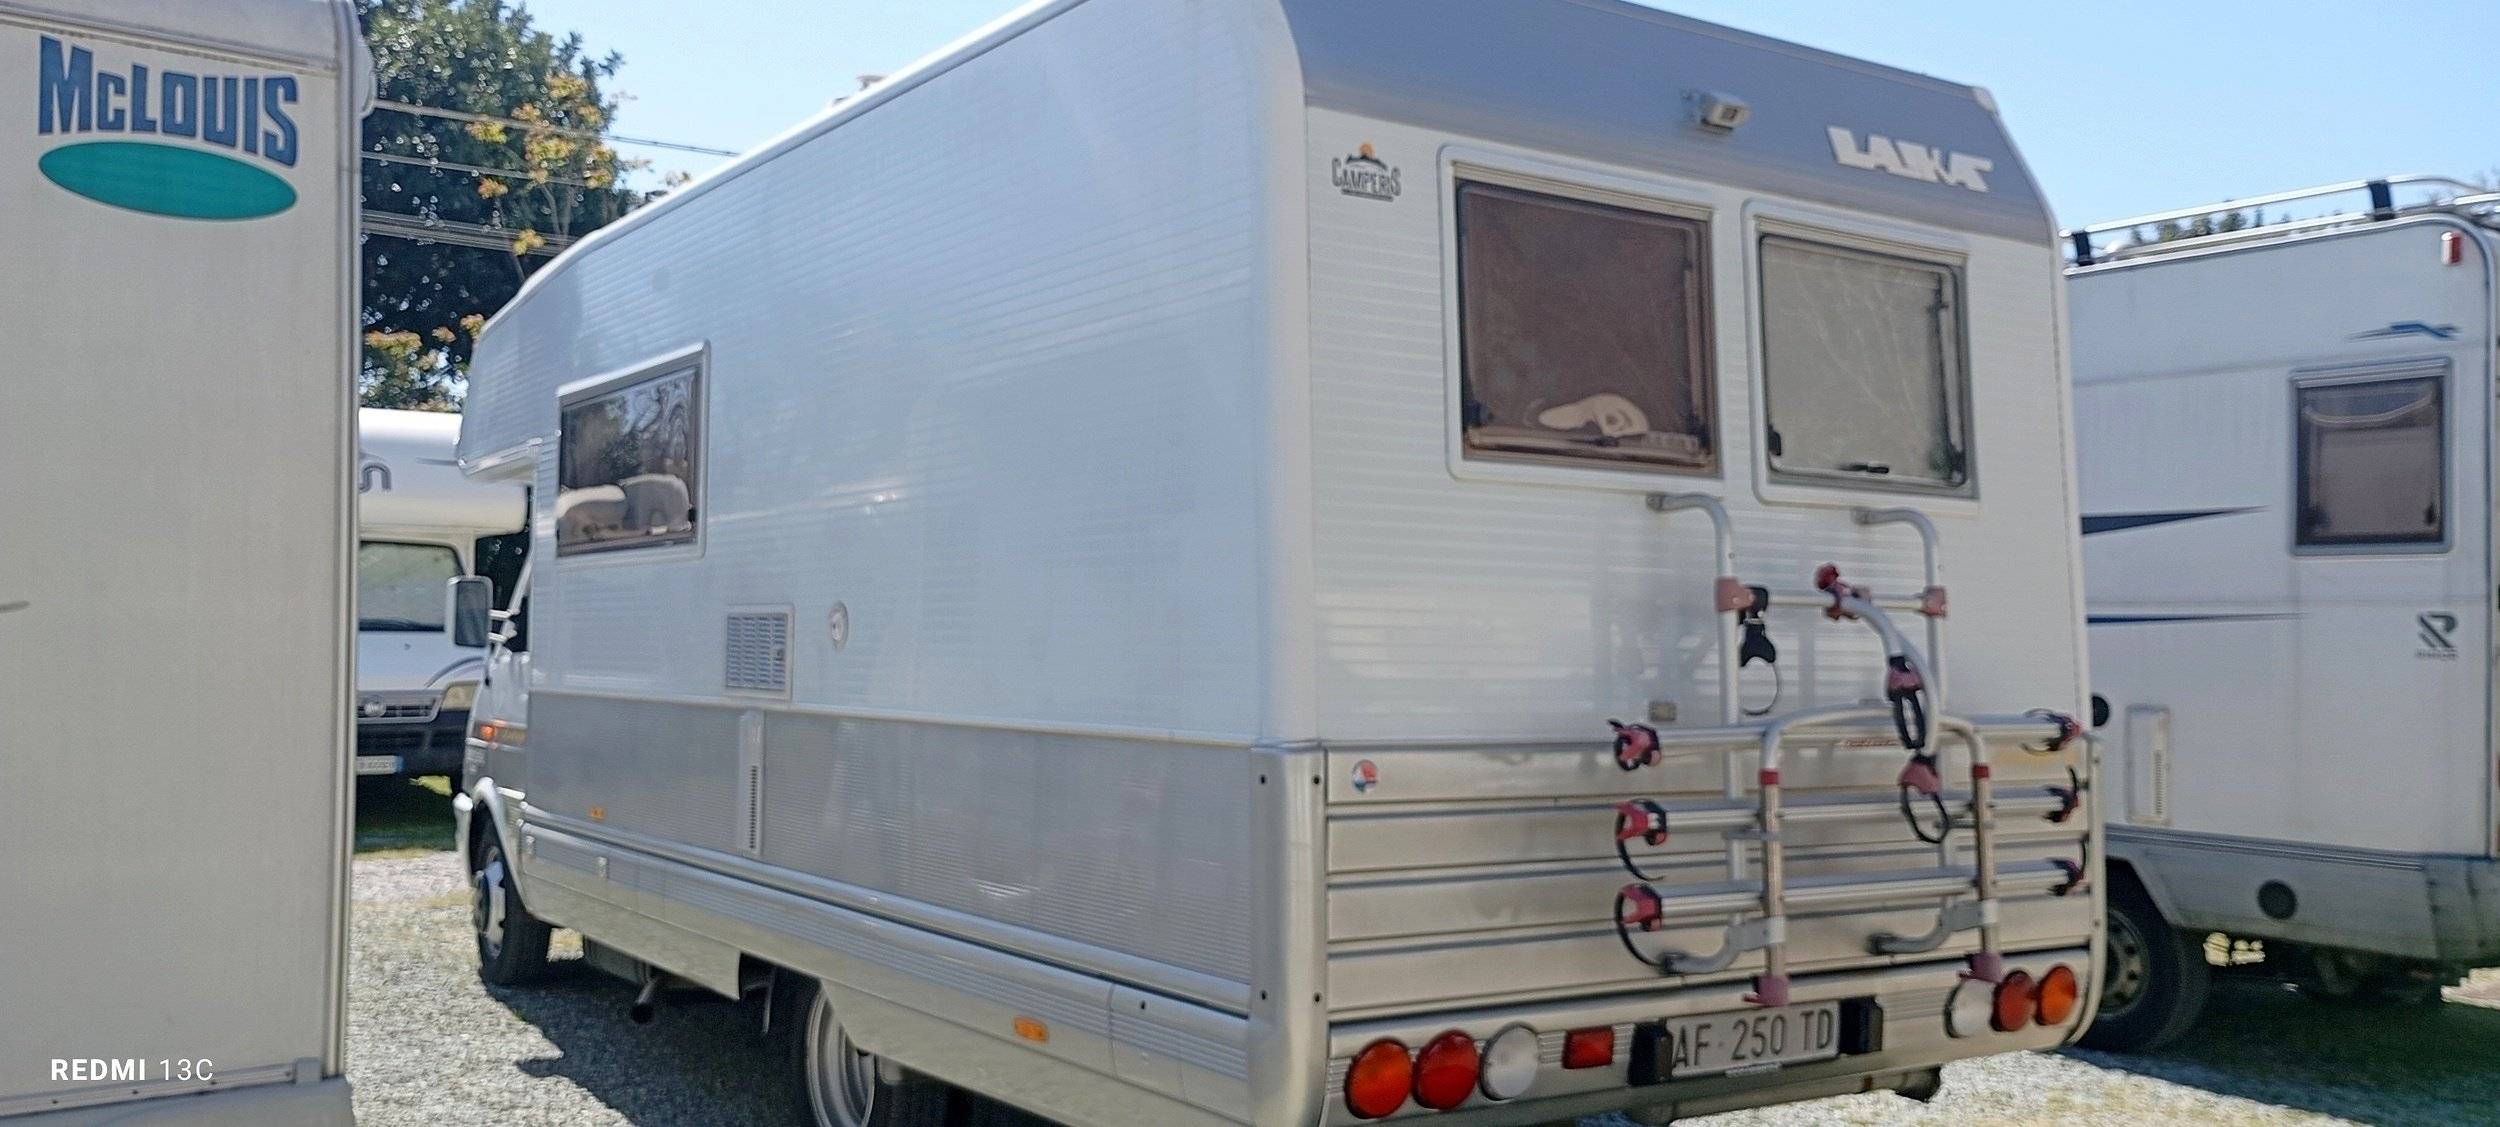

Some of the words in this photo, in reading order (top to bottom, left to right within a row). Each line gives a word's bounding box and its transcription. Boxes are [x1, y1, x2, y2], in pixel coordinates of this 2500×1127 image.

[1672, 1023, 1711, 1068] AF
[1731, 1015, 1787, 1061] 250
[1800, 1008, 1833, 1050] TD
